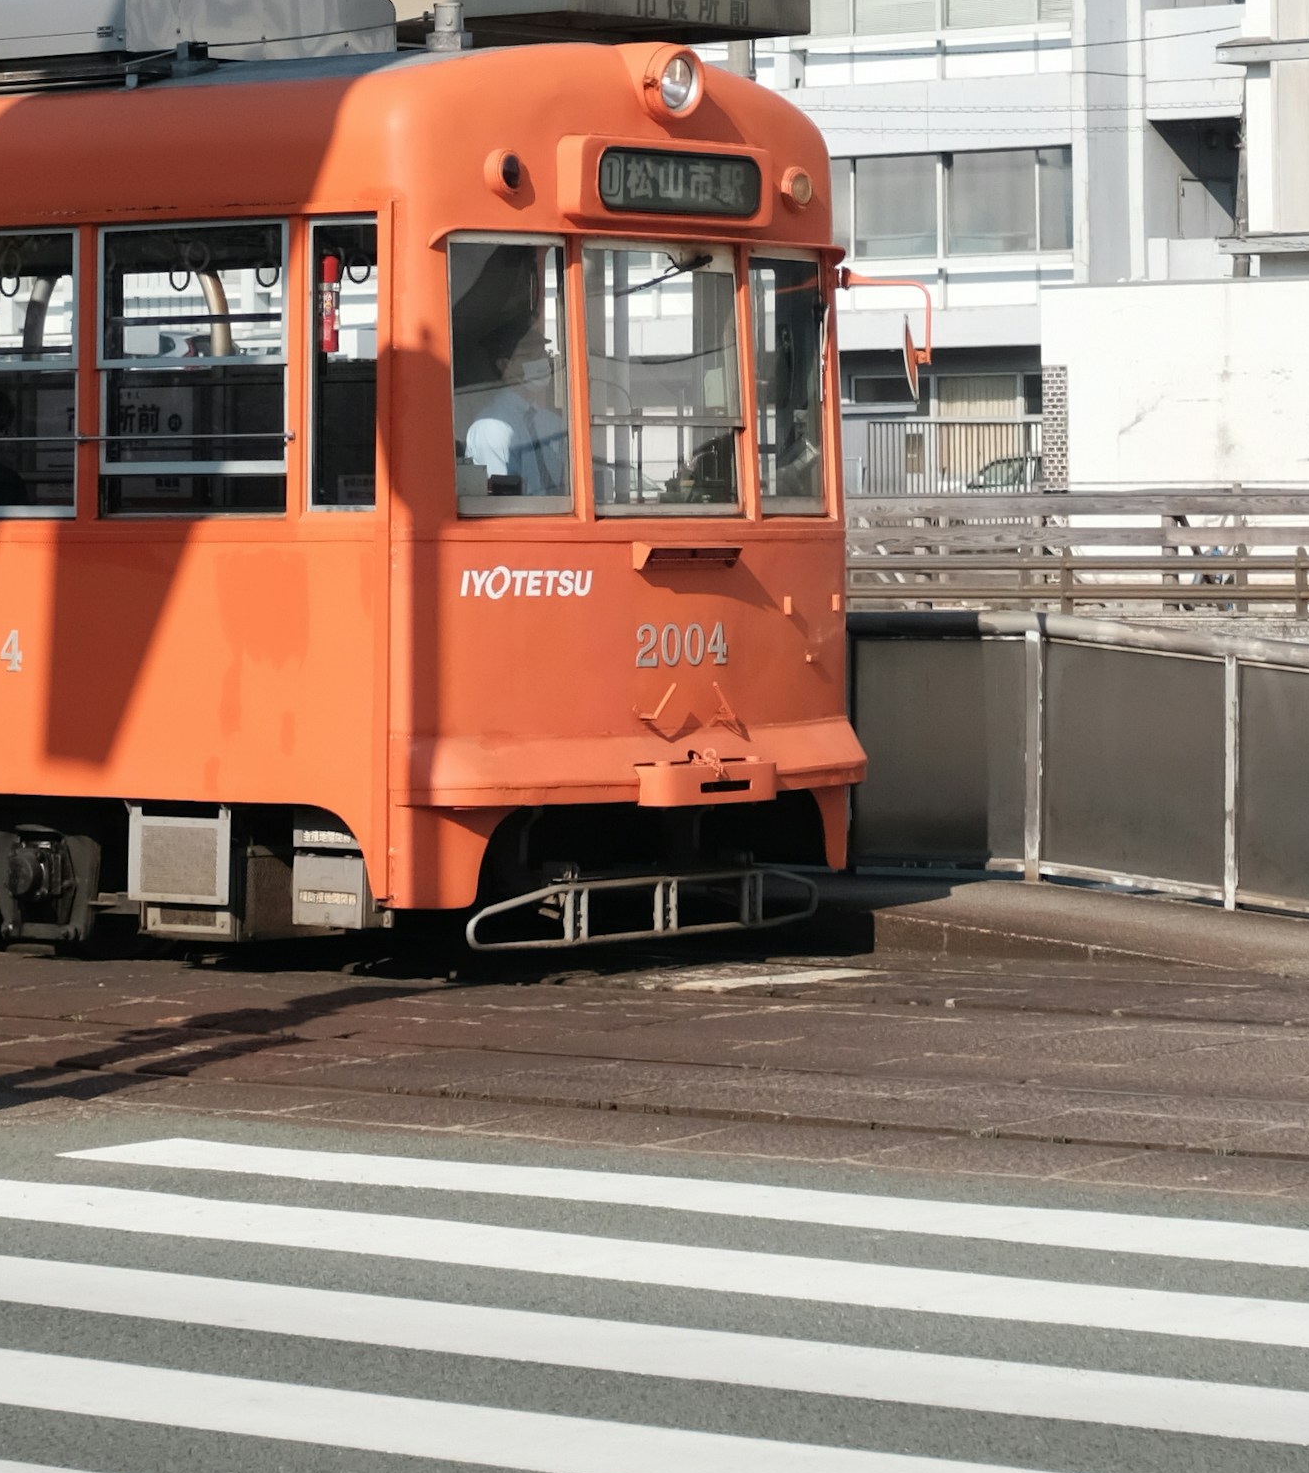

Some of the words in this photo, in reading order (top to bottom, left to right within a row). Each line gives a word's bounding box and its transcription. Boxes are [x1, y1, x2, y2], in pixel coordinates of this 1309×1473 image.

[626, 156, 745, 204] 松山市駅
[459, 565, 593, 600] IYOTETSU
[635, 621, 728, 669] 2004
